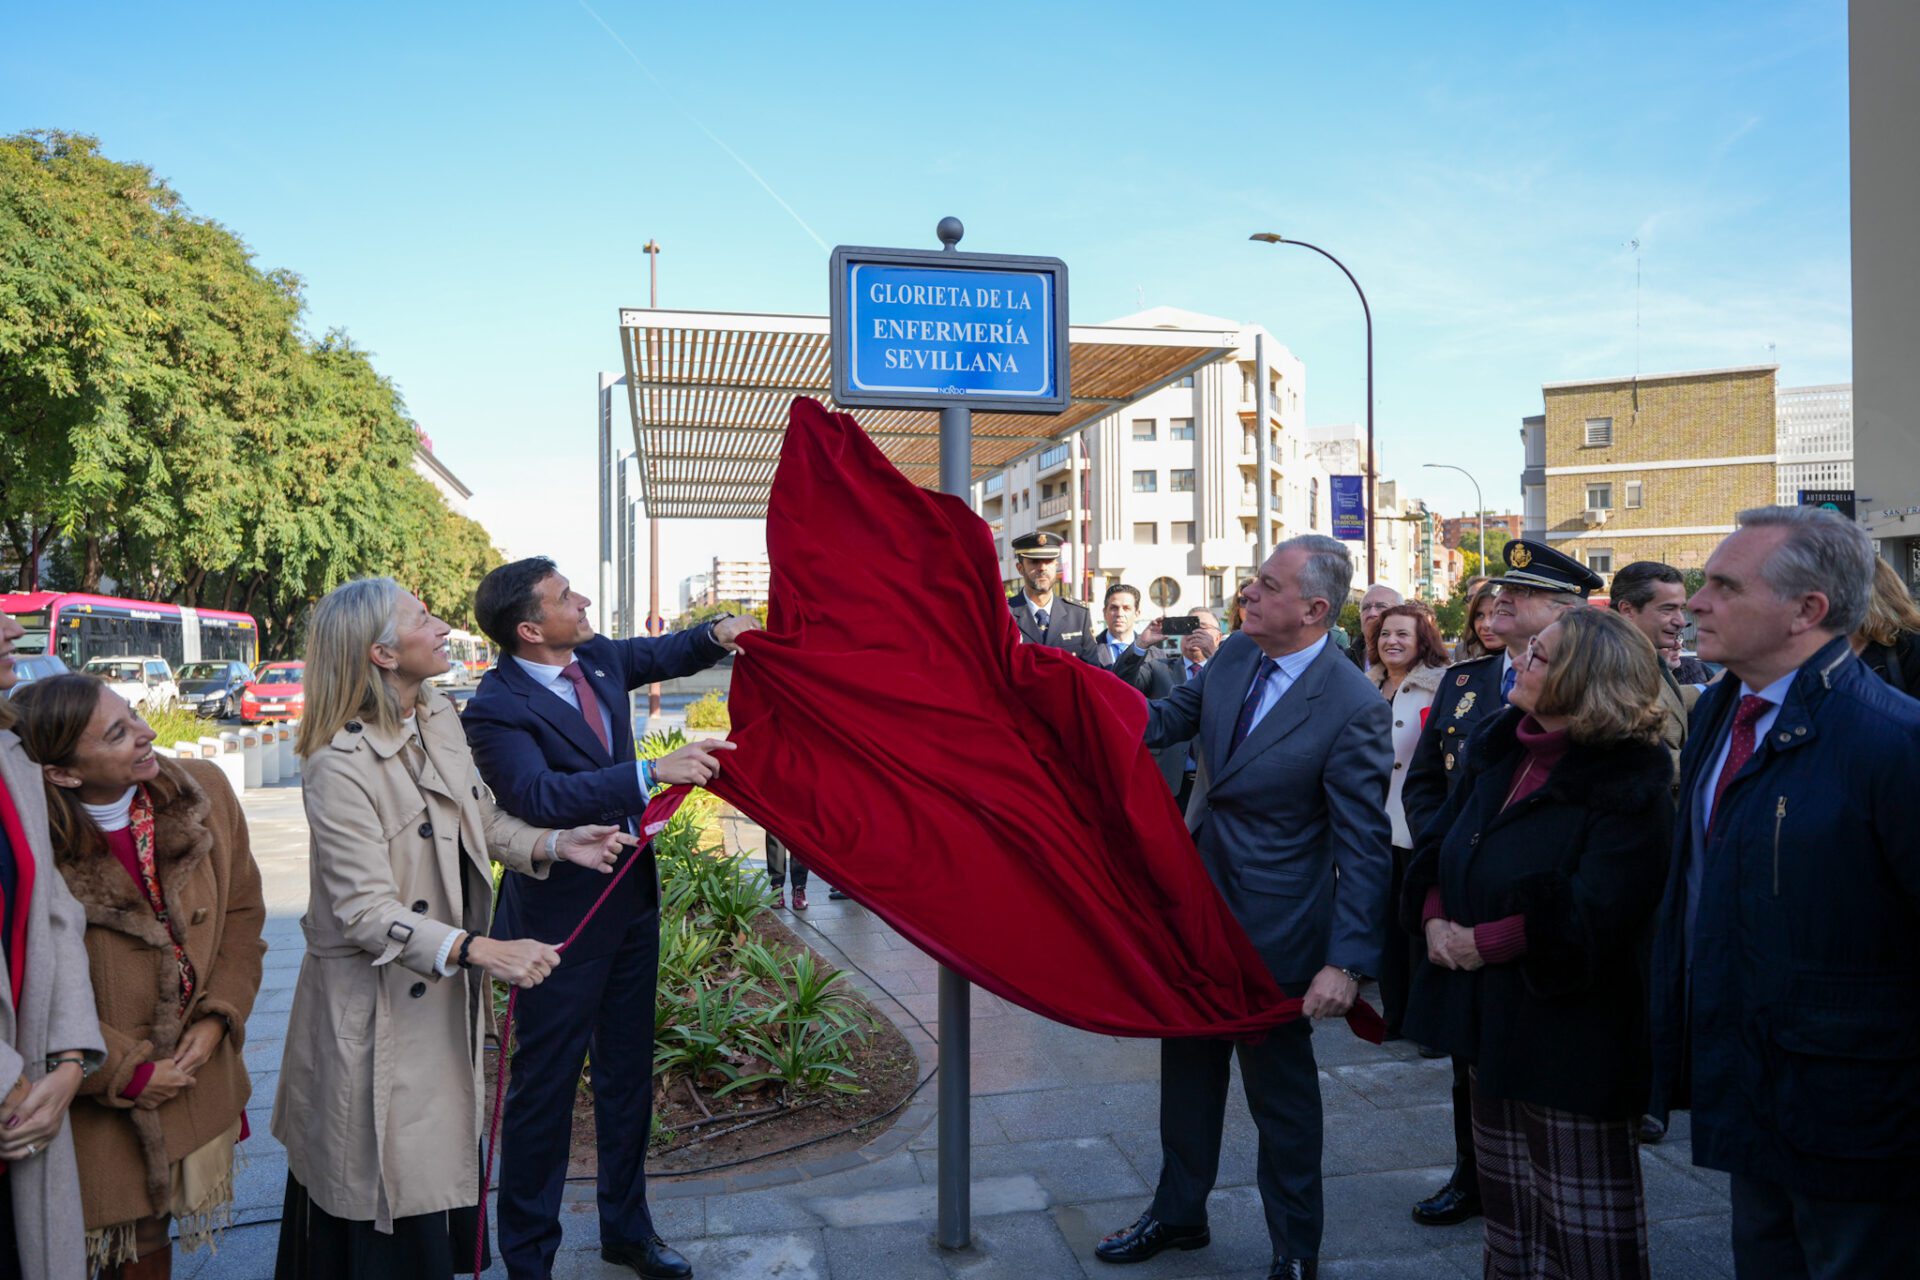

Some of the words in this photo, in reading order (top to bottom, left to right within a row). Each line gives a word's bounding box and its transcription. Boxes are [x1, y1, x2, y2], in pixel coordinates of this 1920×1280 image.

[870, 283, 972, 307] GLORIETA
[976, 288, 1001, 308] DE
[1007, 289, 1032, 310] LA
[873, 318, 1029, 344] ENFERMERÍA
[885, 349, 1019, 373] SEVILLANA
